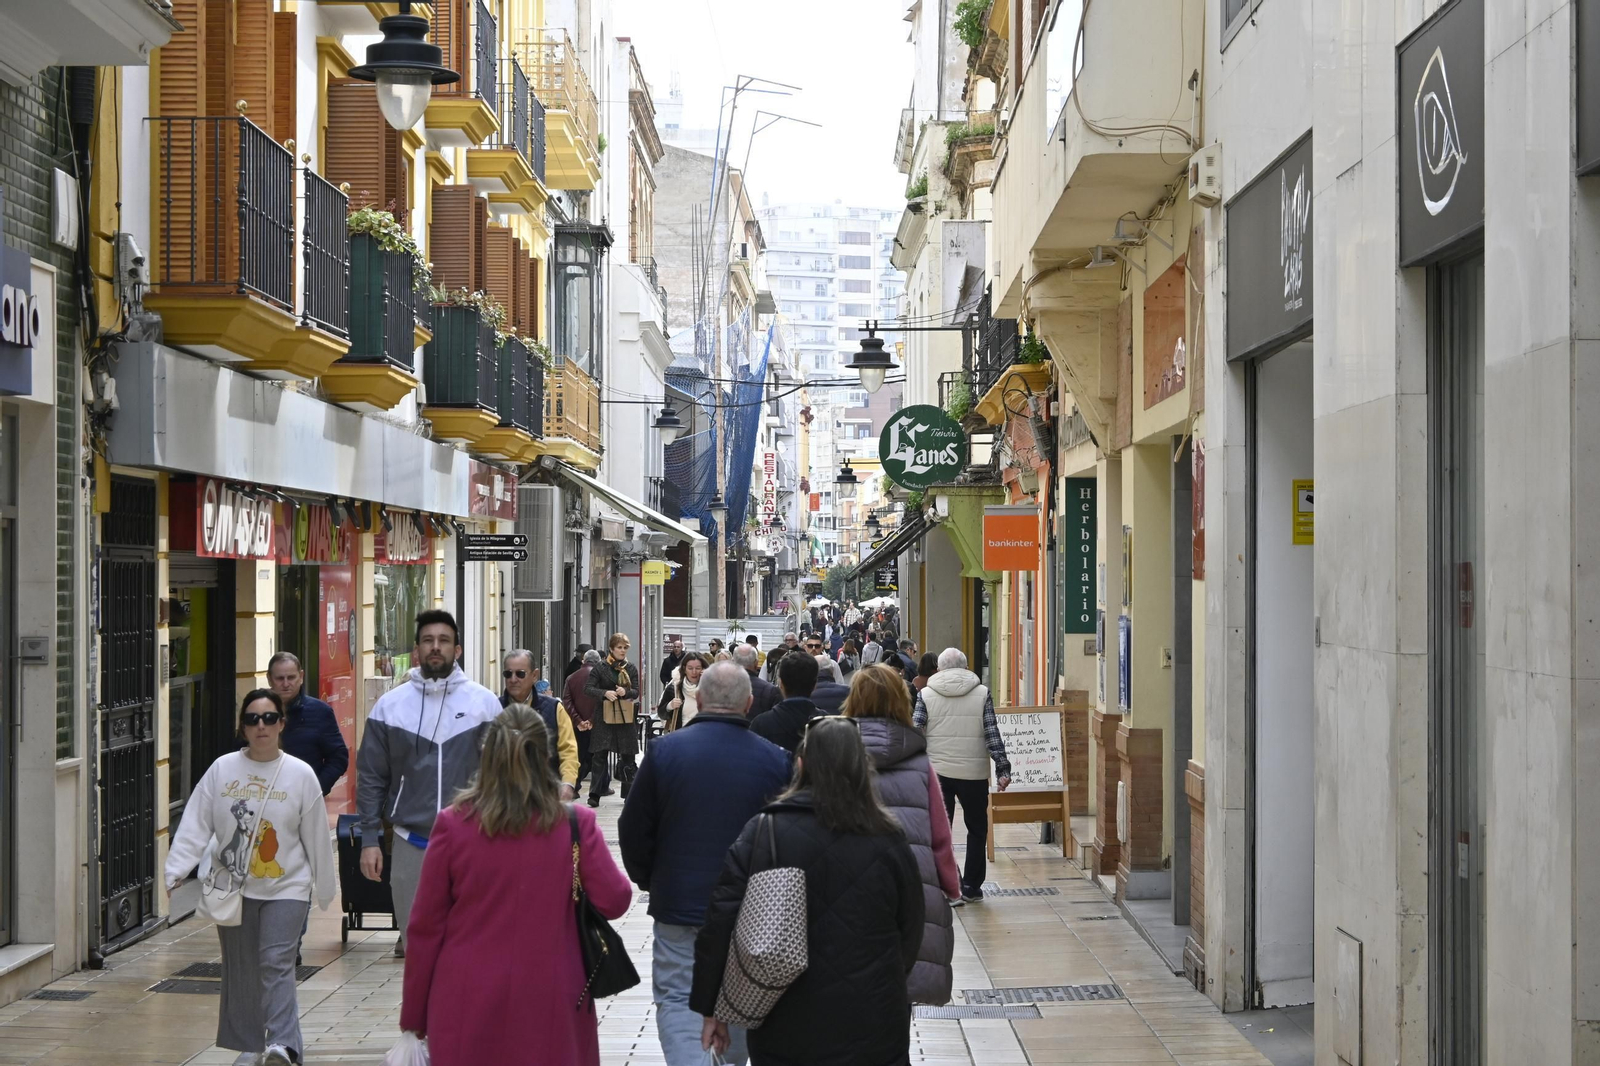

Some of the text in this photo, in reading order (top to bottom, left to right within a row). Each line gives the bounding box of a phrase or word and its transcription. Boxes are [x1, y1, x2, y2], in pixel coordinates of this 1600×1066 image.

[764, 452, 775, 526] RESTAURANTE
[754, 525, 787, 537] CHIO
[1079, 487, 1092, 623] Herbolario
[1010, 714, 1023, 725] ESTE
[1027, 713, 1042, 725] MES
[1025, 769, 1042, 779] gran
[221, 779, 252, 801] Lady
